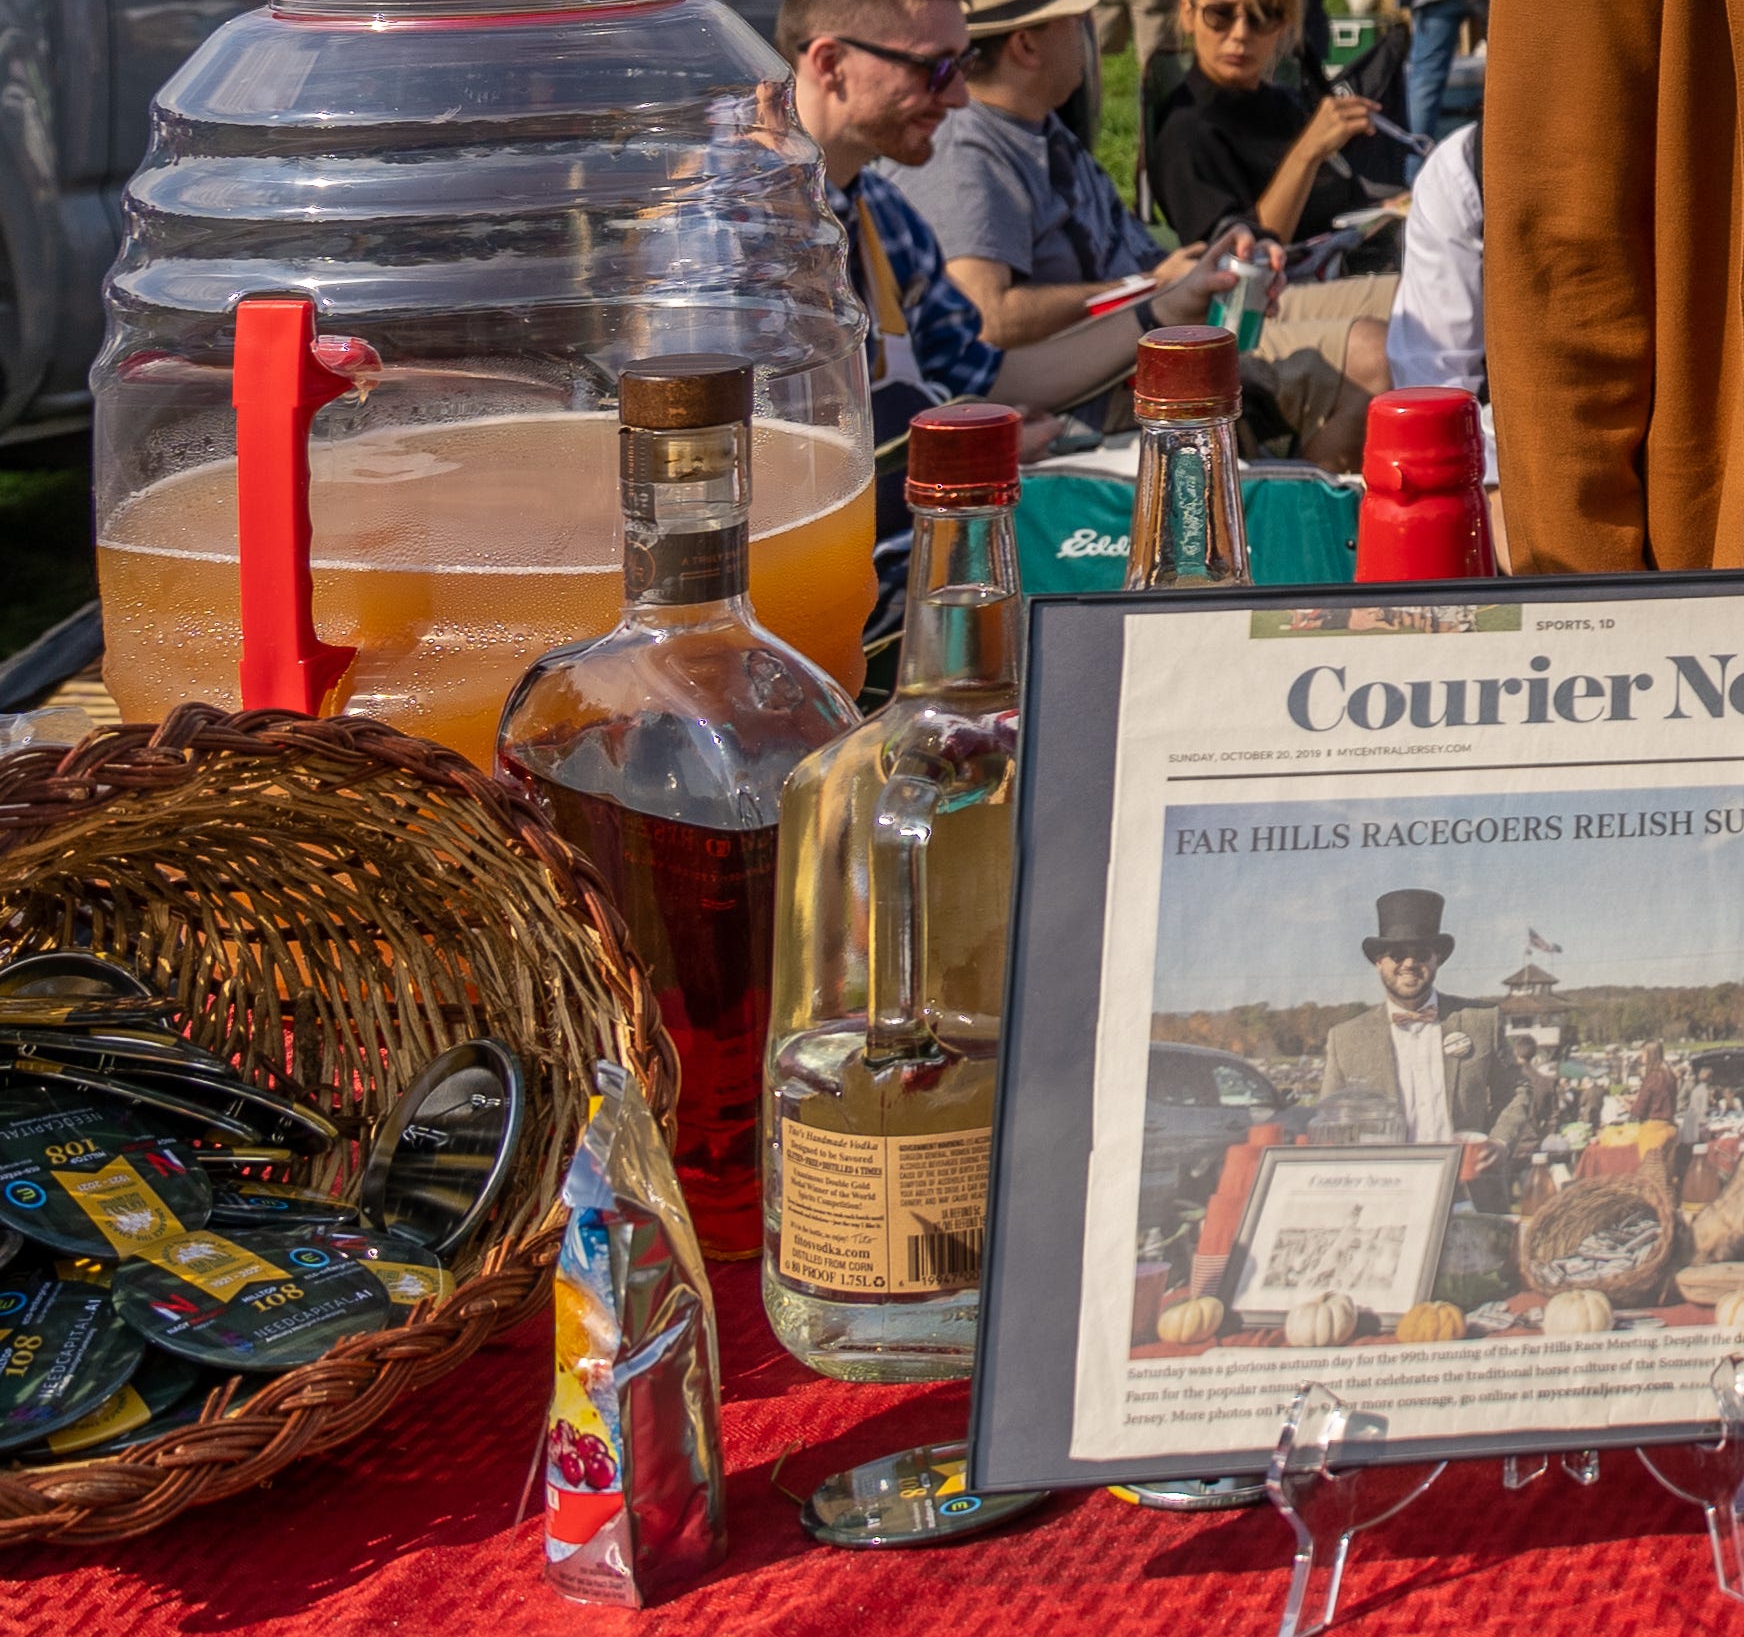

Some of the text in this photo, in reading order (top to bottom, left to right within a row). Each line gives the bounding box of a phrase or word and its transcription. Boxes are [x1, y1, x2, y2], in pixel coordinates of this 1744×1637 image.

[1536, 619, 1615, 632] SPORTS, 1D
[1287, 655, 1654, 732] Courier
[1168, 744, 1472, 763] SUNDAY, OCTOBER 20, 2019 MYCENTRALJERSEY.COM
[1175, 828, 1240, 855] FAR
[1250, 823, 1350, 853] HILLS
[1361, 814, 1562, 848] RACEGOERS
[1573, 810, 1694, 840] RELISH
[45, 1138, 99, 1164] 108
[806, 1130, 847, 1148] Handmade
[849, 1139, 878, 1150] Vodka
[794, 1234, 870, 1259] titosvodka.com
[802, 1264, 836, 1283] PROOF
[824, 1257, 846, 1269] FROM
[848, 1261, 874, 1272] CORN
[242, 1286, 278, 1303] HILLTOP
[251, 1283, 305, 1313] 108
[254, 1288, 374, 1339] NEEDCAPITAL.AI
[5, 1335, 43, 1377] 108
[38, 1299, 102, 1399] NEEDCAPITAL.AI
[1127, 1366, 1185, 1380] Saturday
[1188, 1367, 1213, 1376] was
[1226, 1361, 1277, 1376] glorious
[1279, 1360, 1329, 1371] autumn
[1331, 1355, 1354, 1369] day
[1357, 1354, 1375, 1366] for
[1377, 1353, 1398, 1364] the
[1400, 1350, 1429, 1363] 99th
[1432, 1348, 1481, 1362] running
[1482, 1345, 1498, 1357] of
[1501, 1344, 1519, 1356] the
[1522, 1343, 1540, 1355] Far
[1544, 1341, 1572, 1354] Hills
[1575, 1340, 1599, 1352] Race
[1603, 1336, 1657, 1351] Meeting.
[1664, 1334, 1710, 1349] Despite
[1712, 1333, 1731, 1345] the
[1375, 1371, 1439, 1386] celebrates
[1451, 1369, 1464, 1381] the
[1467, 1364, 1533, 1380] traditional
[1536, 1363, 1569, 1376] horse
[1573, 1360, 1618, 1375] culture
[1620, 1359, 1633, 1370] of
[1636, 1358, 1656, 1369] the
[1659, 1355, 1716, 1369] Somerset
[1537, 1380, 1674, 1401] mycentraljersey.com
